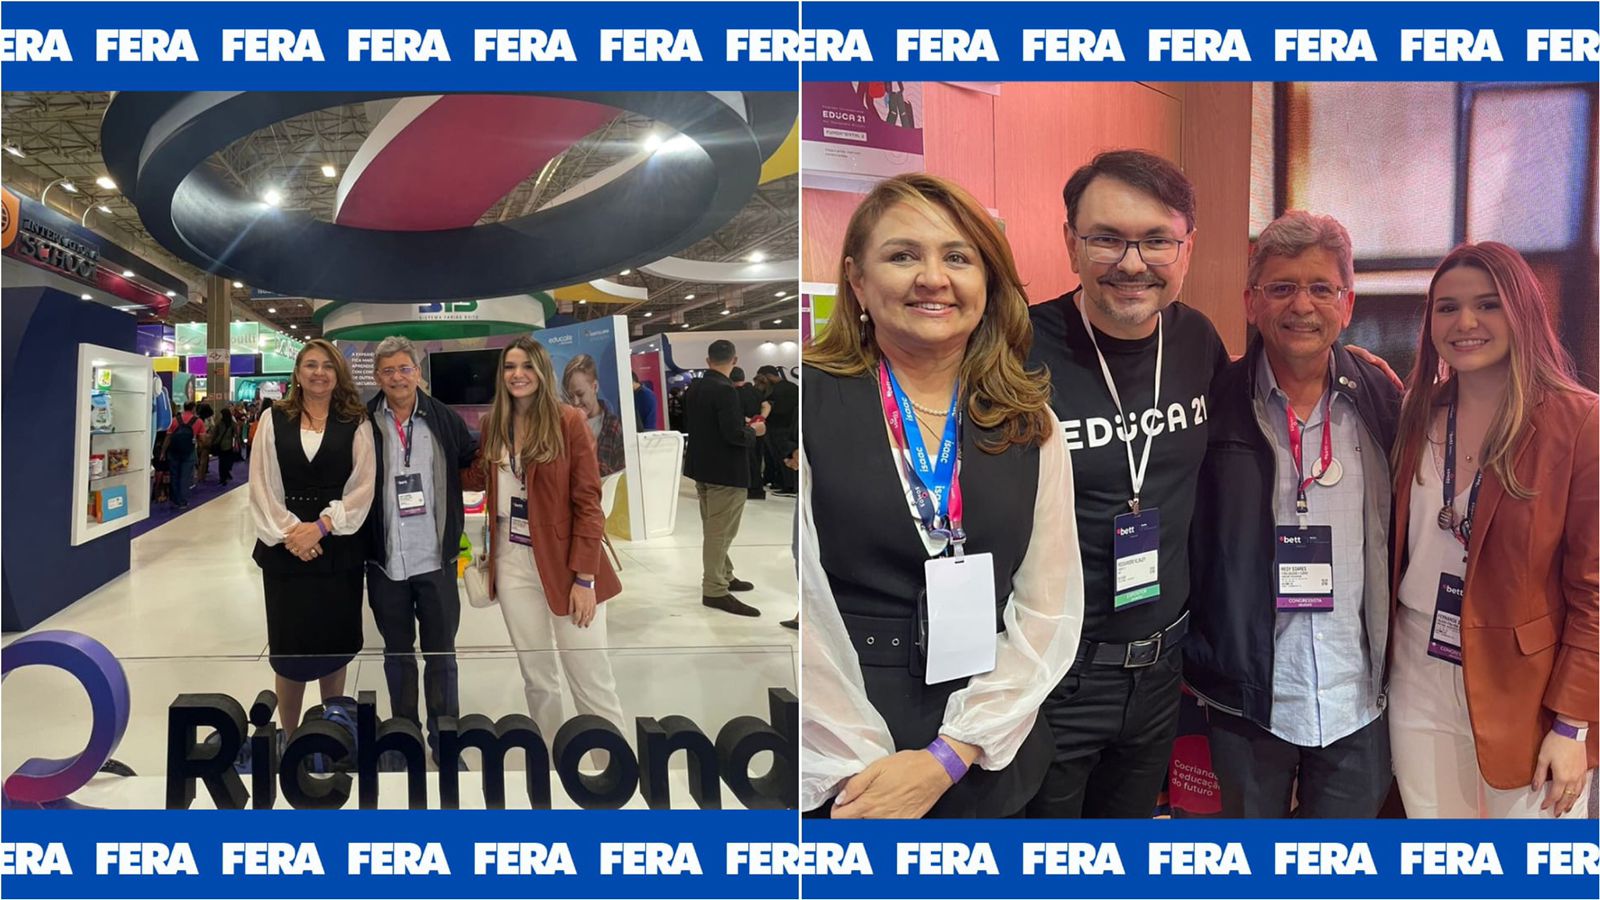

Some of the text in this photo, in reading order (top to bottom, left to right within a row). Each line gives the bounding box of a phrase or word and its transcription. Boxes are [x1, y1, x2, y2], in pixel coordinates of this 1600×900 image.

[901, 397, 913, 422] isaac
[1191, 394, 1208, 426] 21
[916, 447, 929, 473] isaac
[941, 439, 954, 464] isaac
[1120, 526, 1135, 536] bett
[1283, 536, 1302, 544] bett
[1446, 584, 1464, 597] bett
[164, 687, 799, 809] Richmond
[1171, 777, 1214, 796] do futuro
